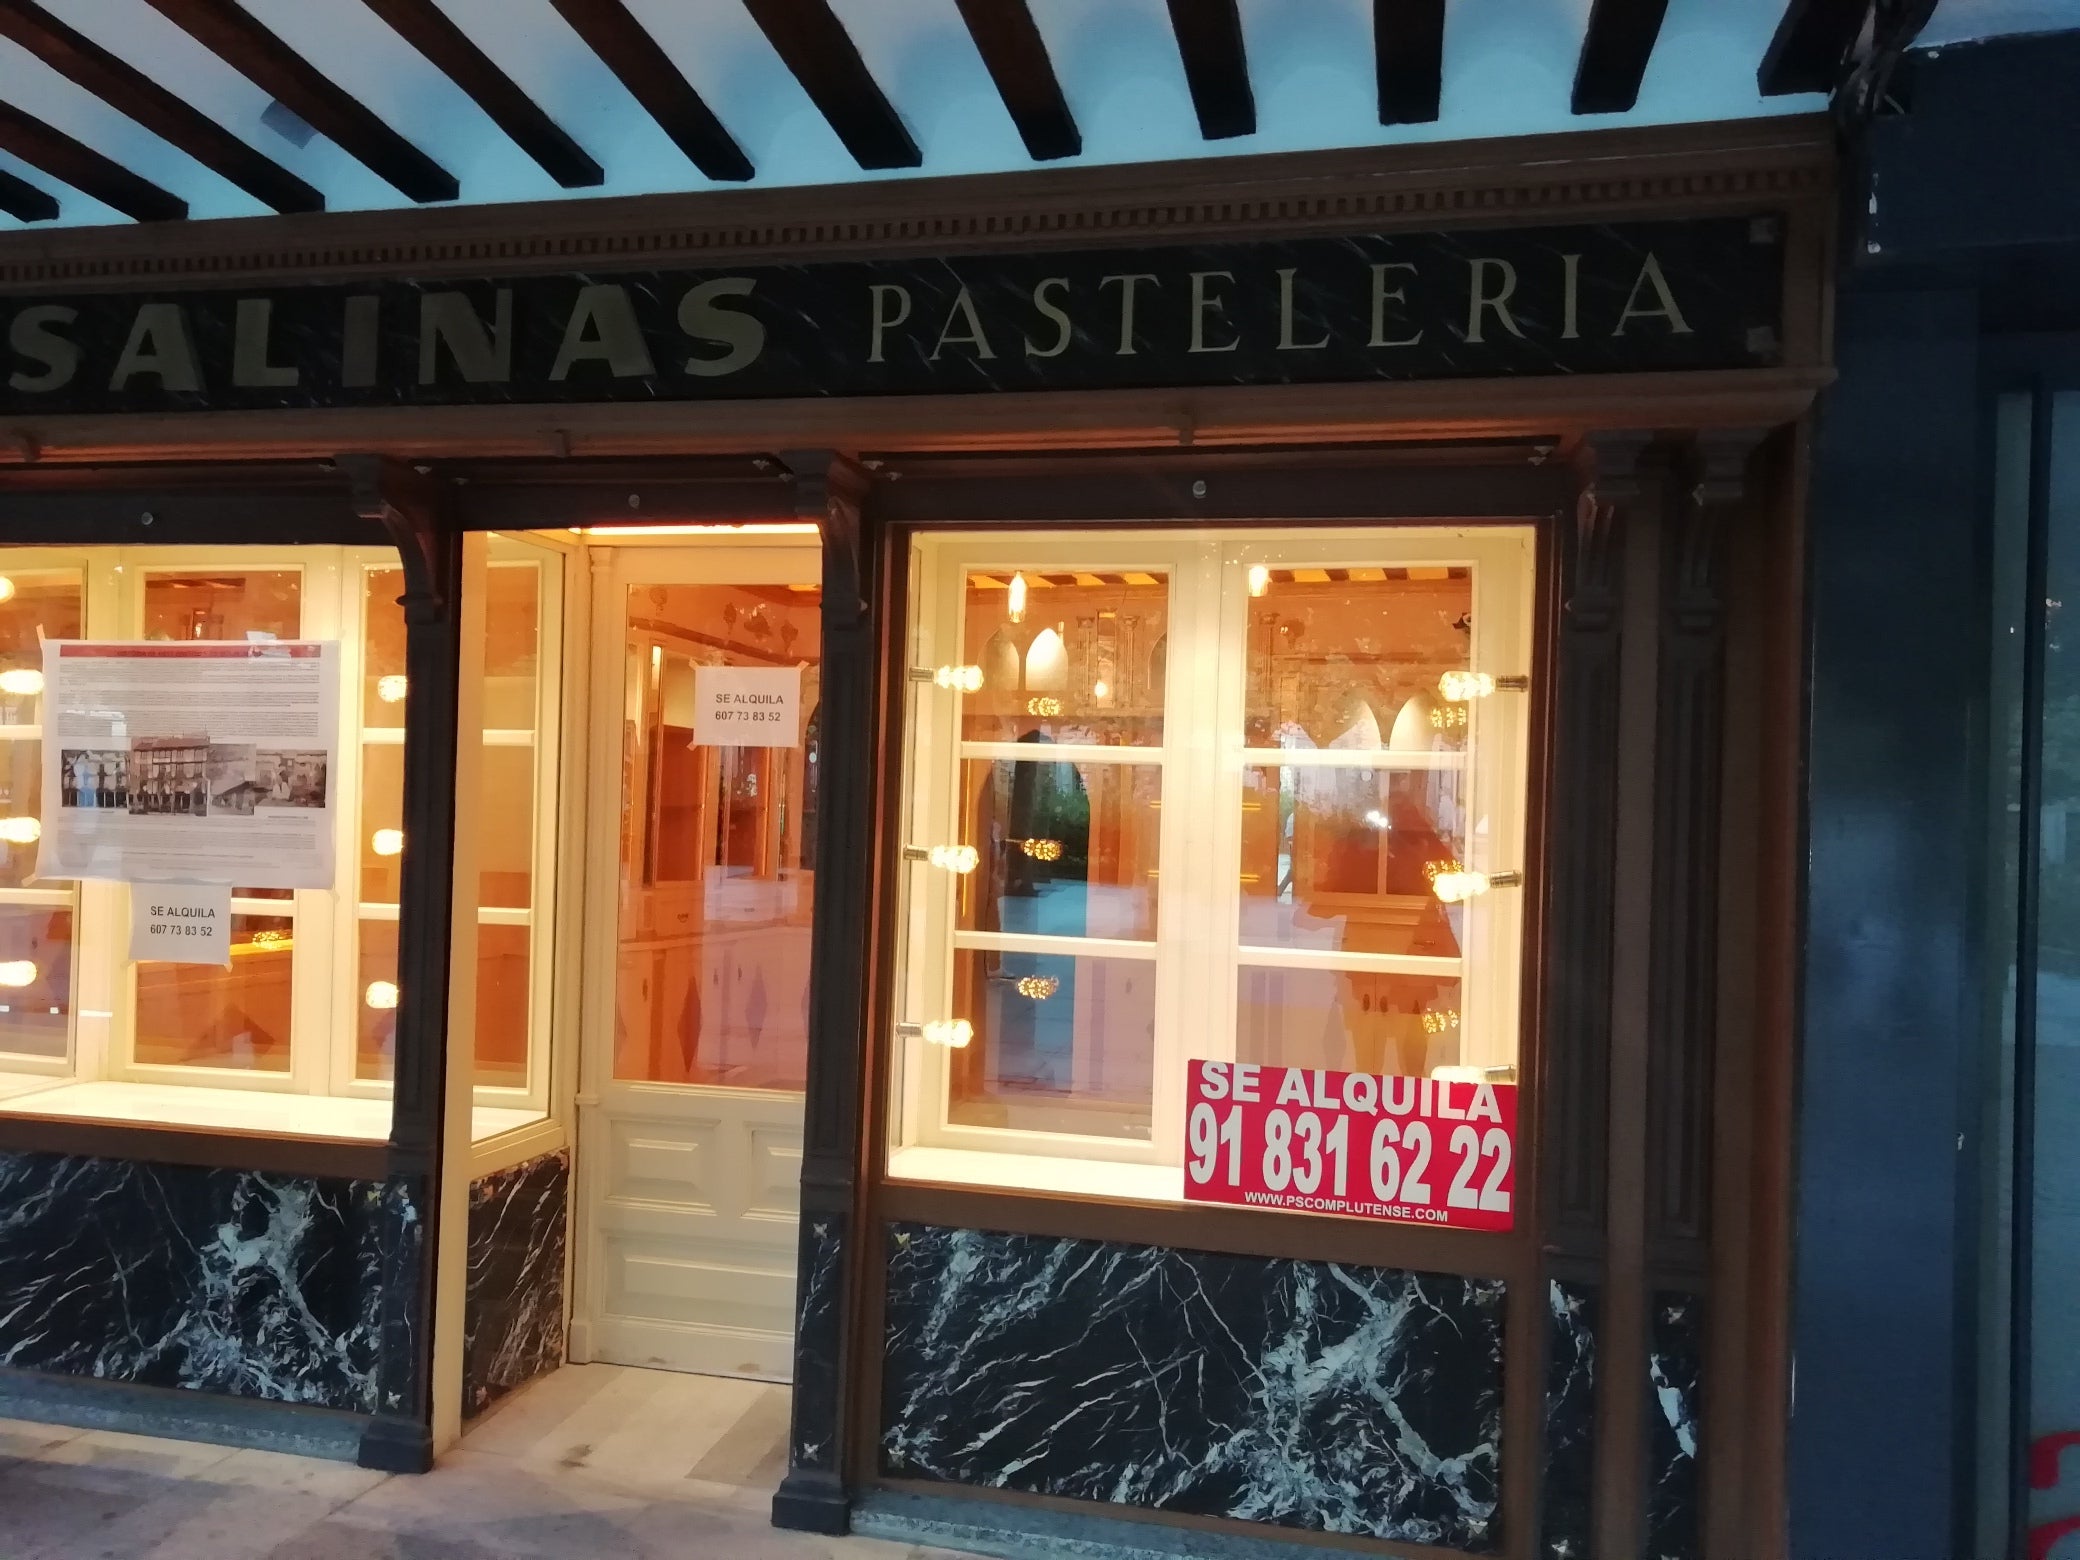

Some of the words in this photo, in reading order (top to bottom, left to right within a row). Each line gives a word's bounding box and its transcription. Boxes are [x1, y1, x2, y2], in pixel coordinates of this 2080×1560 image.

[8, 276, 769, 395] SALINAS
[866, 249, 1694, 365] PASTELERIA
[715, 693, 731, 704] SE
[733, 694, 784, 705] ALQUILA
[715, 710, 734, 721] 607
[737, 711, 749, 721] 73
[752, 711, 765, 721] 83
[768, 711, 781, 722] 52
[150, 905, 164, 916] SE
[166, 906, 216, 918] ALQUILA
[150, 923, 167, 934] 607
[170, 925, 182, 936] 73
[185, 925, 197, 936] 83
[200, 926, 213, 937] 52
[1199, 1060, 1262, 1103] SE
[1275, 1067, 1504, 1124] ALQUILA
[1188, 1102, 1244, 1187] 91
[1262, 1108, 1350, 1197] 831
[1369, 1118, 1433, 1205] 62
[1446, 1124, 1513, 1213] 22
[1244, 1190, 1449, 1222] WWW.PSCOMPLUTENSE.COM
